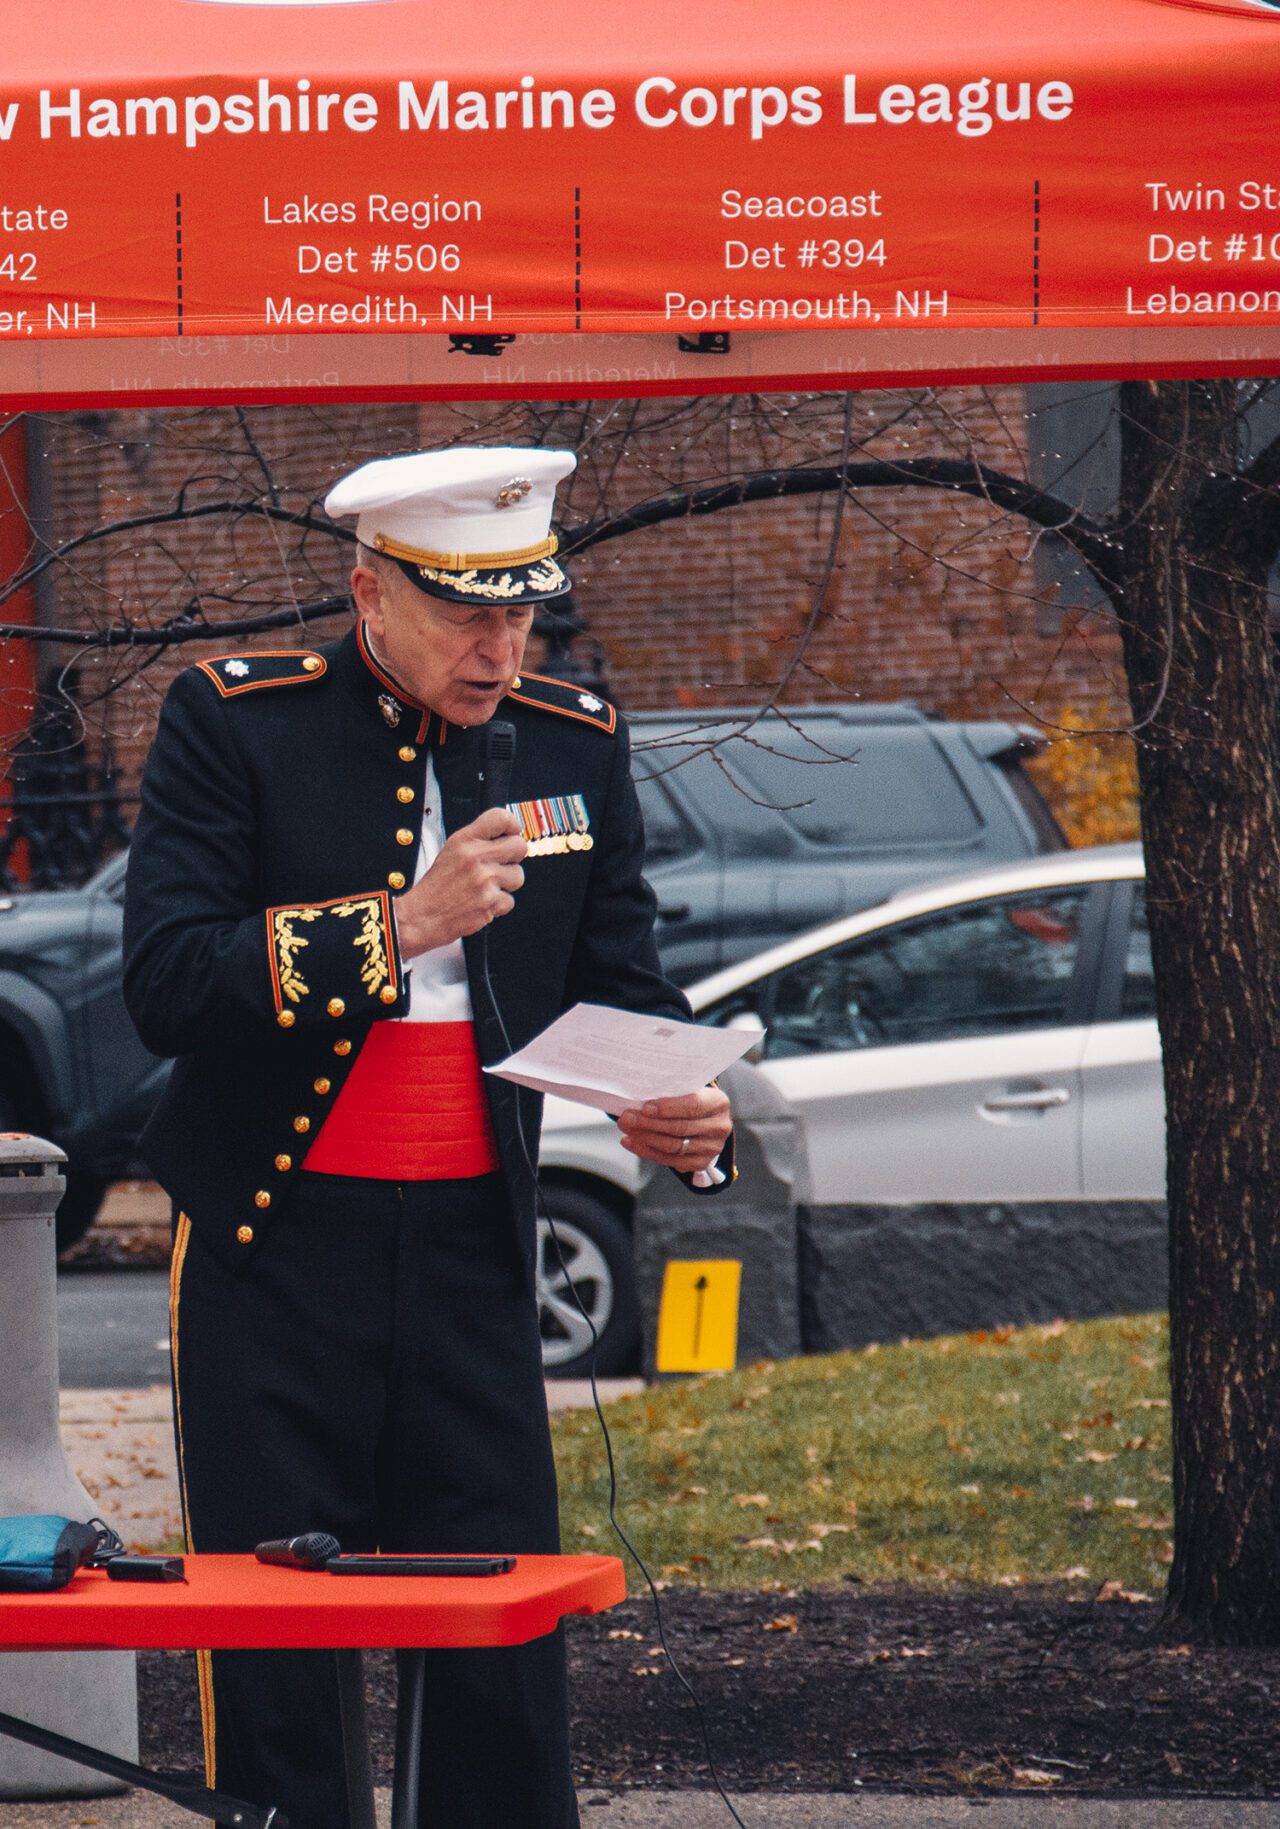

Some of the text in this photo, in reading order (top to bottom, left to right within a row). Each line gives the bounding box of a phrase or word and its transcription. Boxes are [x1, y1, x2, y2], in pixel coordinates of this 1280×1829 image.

[38, 79, 378, 148] Hampshire
[397, 75, 616, 131] Marine
[634, 75, 823, 140] Corps
[843, 73, 1074, 137] League
[721, 189, 882, 218] Seacoast
[1145, 181, 1280, 211] Twin St
[264, 193, 481, 230] Lakes Region
[298, 243, 461, 273] Det #506
[725, 238, 887, 269] Det #394
[1149, 234, 1212, 263] Det
[265, 294, 492, 327] Meredith, NH
[665, 290, 948, 322] Portsmouth, NH
[1126, 285, 1280, 315] Lebanon
[46, 302, 97, 330] NH
